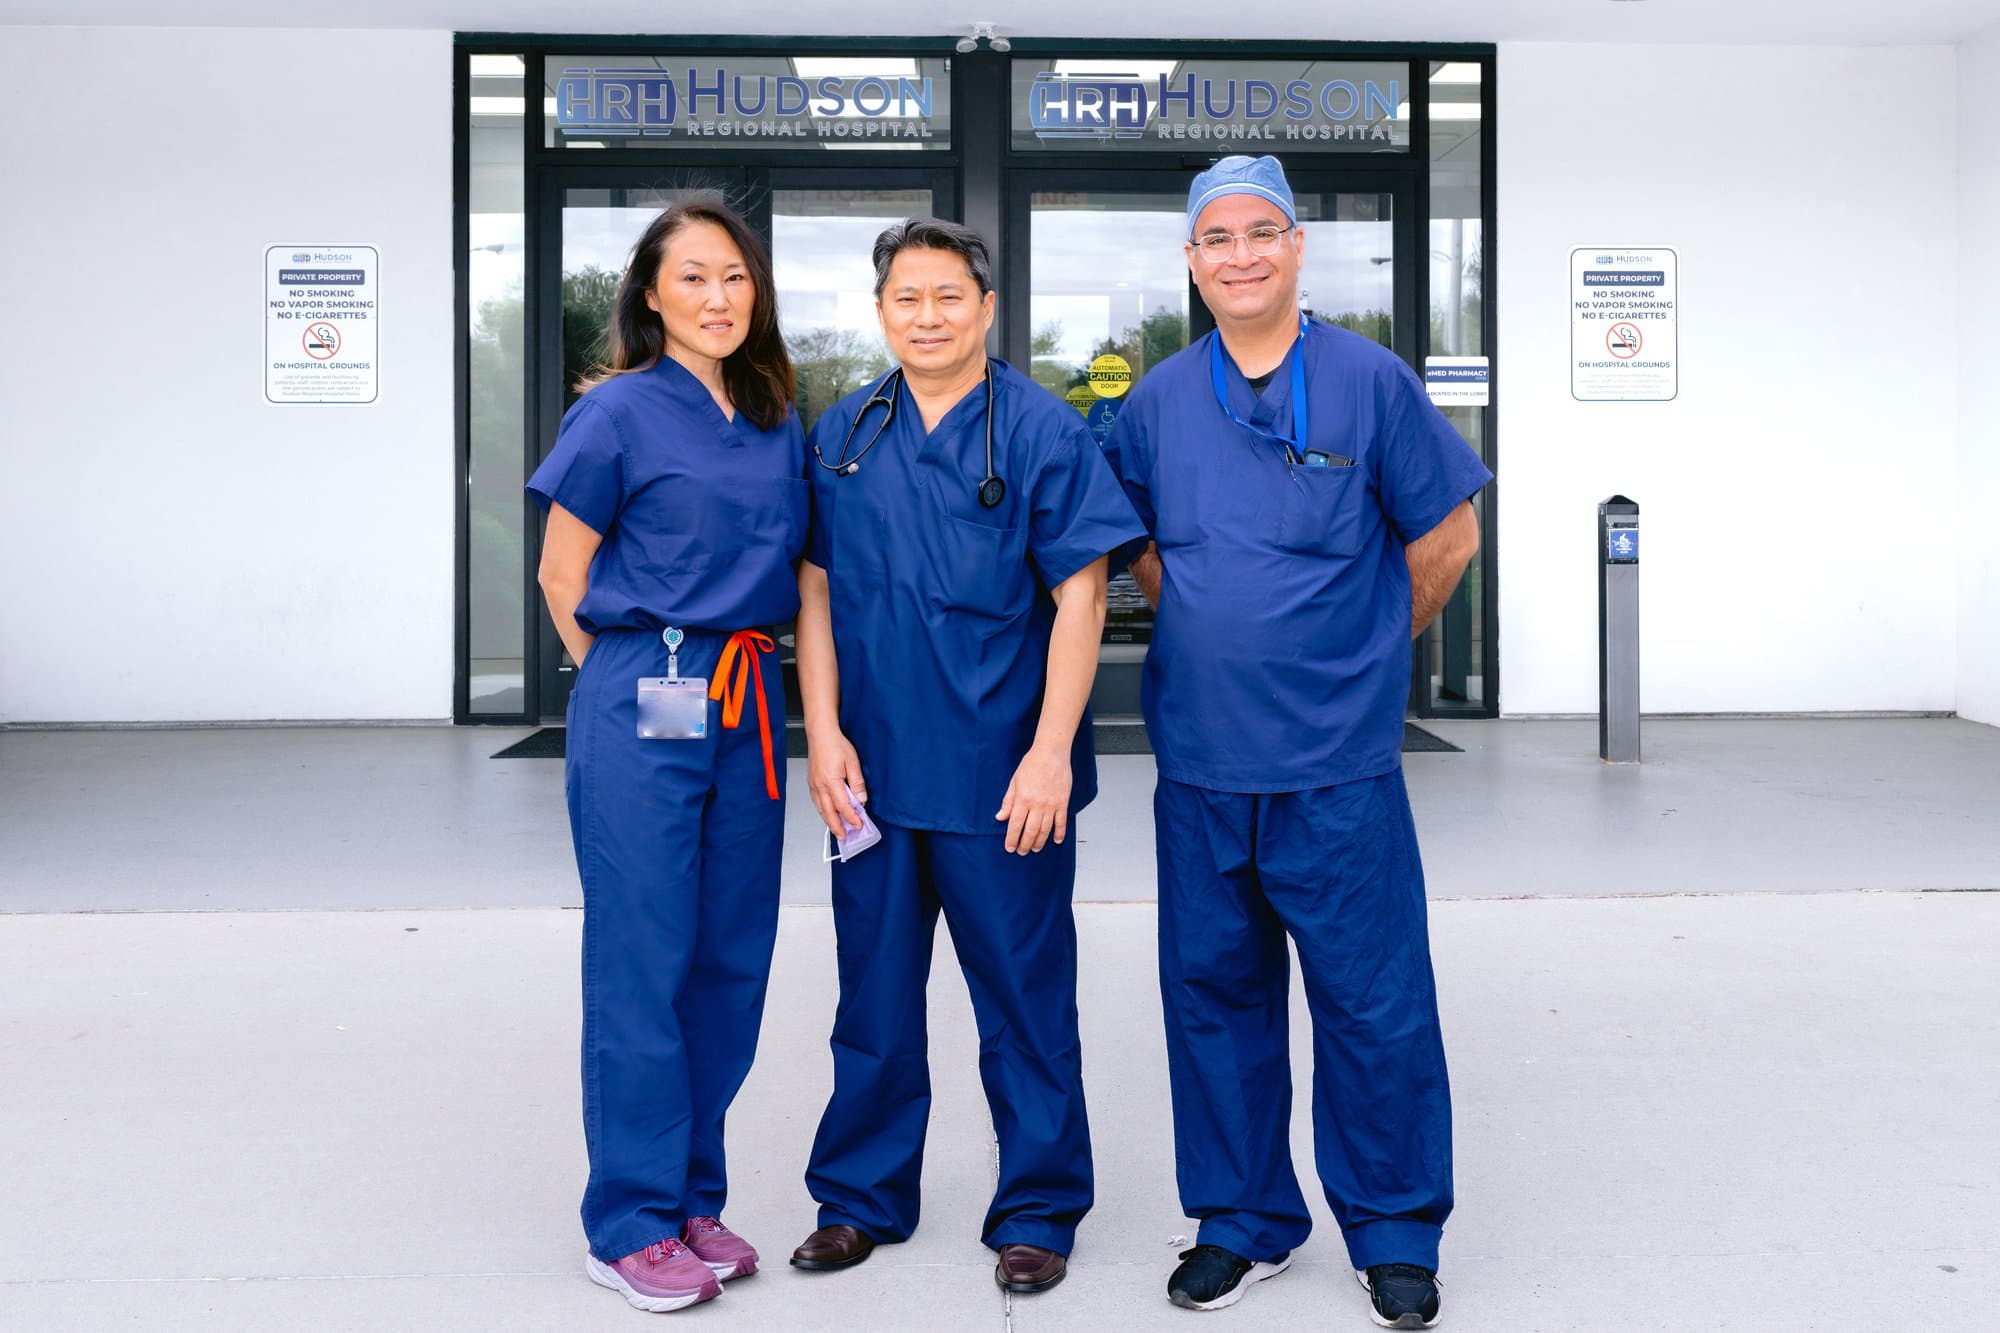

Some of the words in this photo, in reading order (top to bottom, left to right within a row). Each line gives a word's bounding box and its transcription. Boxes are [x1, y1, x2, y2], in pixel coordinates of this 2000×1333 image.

[686, 67, 934, 117] HUDSON
[1158, 72, 1399, 121] HUDSON
[565, 82, 668, 121] HRH
[1039, 85, 1140, 124] HRH
[686, 120, 807, 137] REGIONAL
[817, 121, 933, 137] HOSPITAL
[1157, 124, 1276, 140] REGIONAL
[1286, 124, 1399, 141] HOSPITAL
[282, 273, 317, 281] PRIVATE
[318, 273, 362, 281] PROPERTY
[289, 289, 305, 298] NO
[307, 289, 355, 298] SMOKING
[1593, 290, 1607, 298] NO
[1610, 290, 1655, 298] SMOKING
[270, 300, 285, 309] NO
[288, 300, 324, 309] VAPOR
[326, 300, 374, 309] SMOKING
[1575, 301, 1590, 310] NO
[1592, 301, 1626, 310] VAPOR
[1628, 301, 1673, 310] SMOKING
[277, 311, 293, 320] NO
[295, 311, 367, 320] E-CIGARETTES
[1581, 312, 1596, 320] NO
[1598, 312, 1667, 320] E-CIGARETTES
